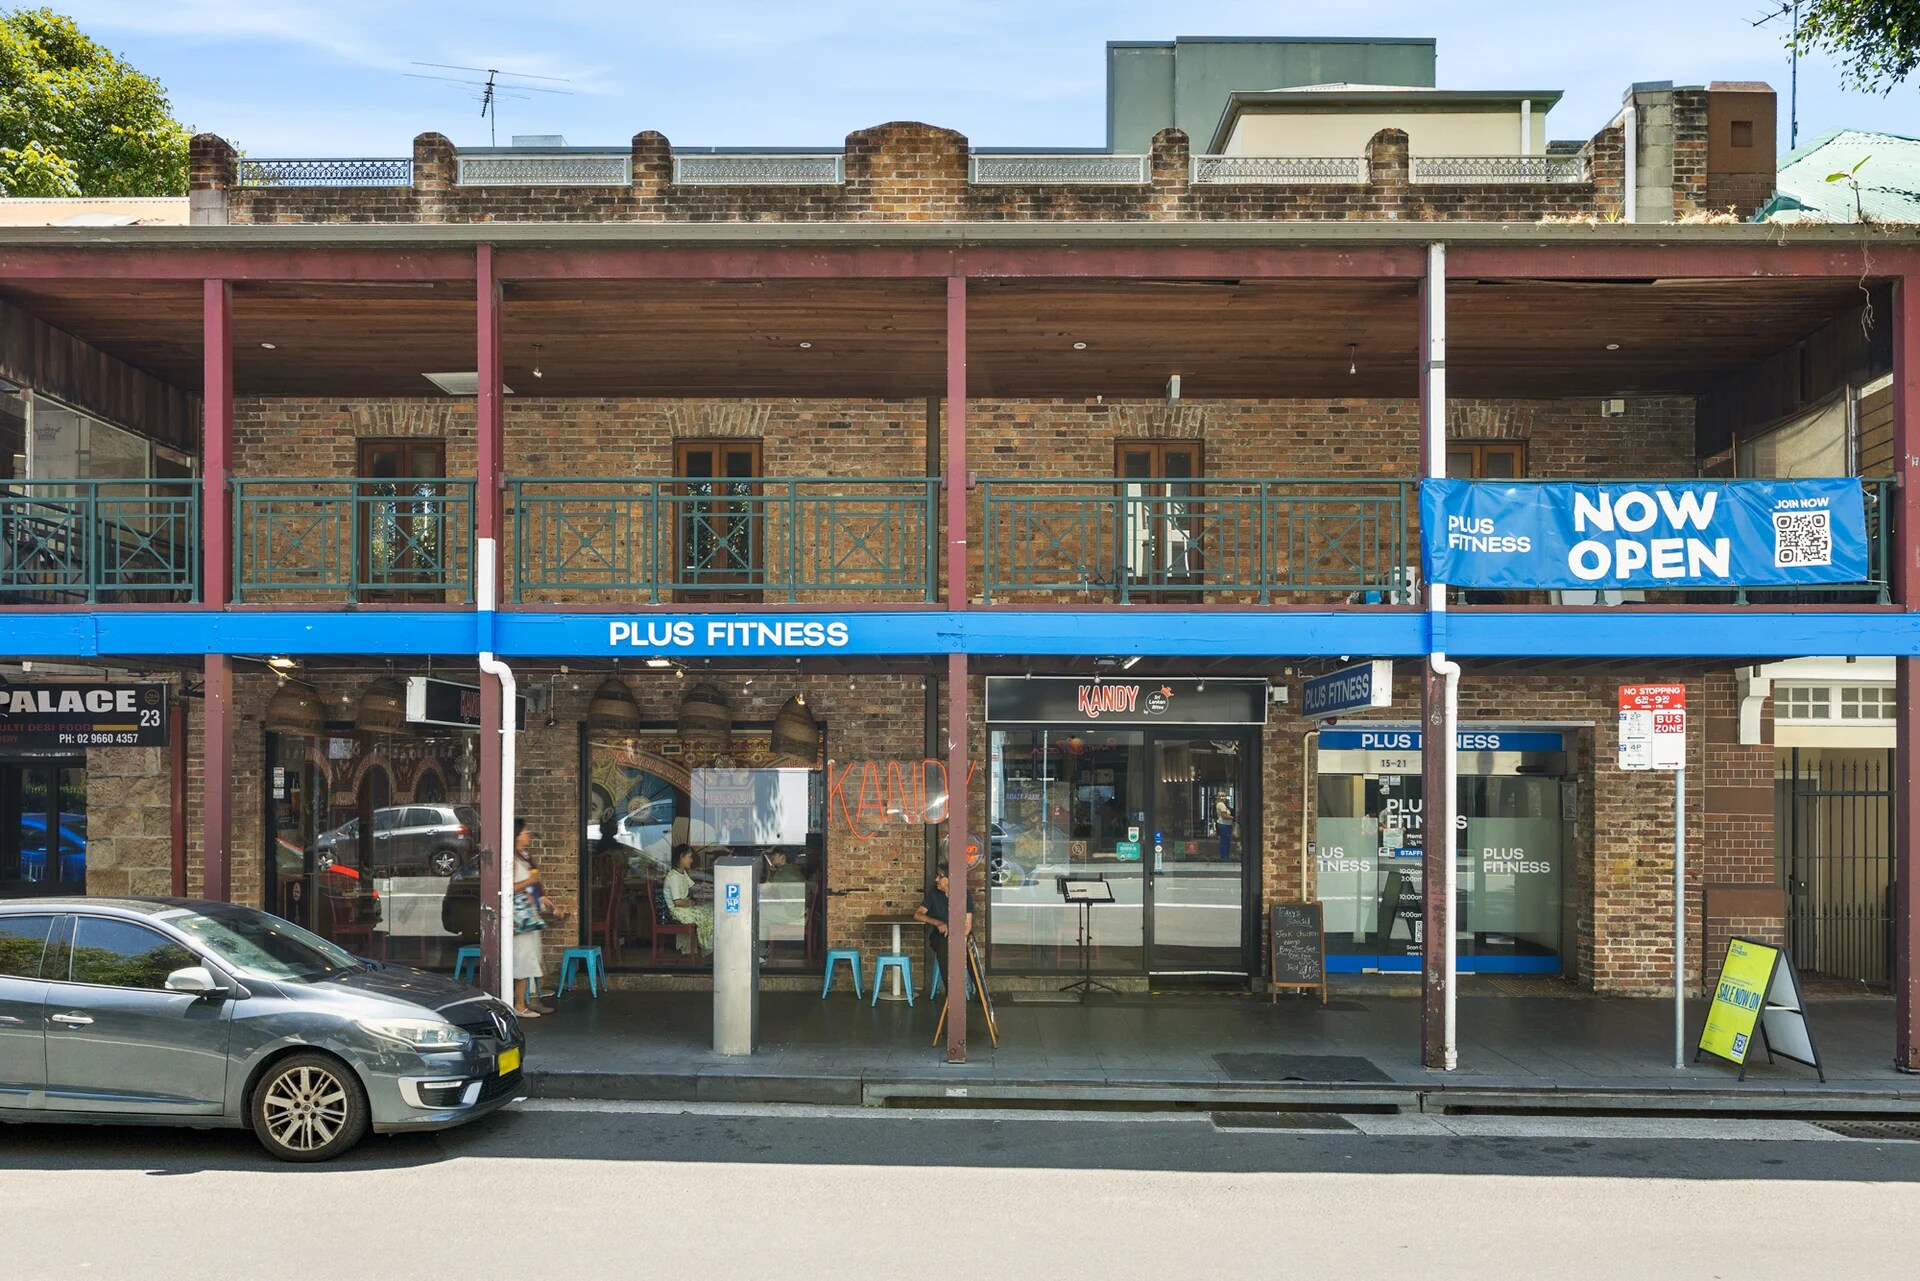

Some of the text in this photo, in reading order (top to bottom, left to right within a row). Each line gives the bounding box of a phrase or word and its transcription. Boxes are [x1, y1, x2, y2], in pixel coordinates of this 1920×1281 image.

[1774, 497, 1829, 509] JOIN NOW
[1573, 490, 1718, 533] NOW
[1448, 515, 1495, 534] PLUS
[1448, 533, 1531, 553] FITNESS
[1567, 537, 1731, 581] OPEN
[609, 622, 849, 647] PLUS FITNESS
[1305, 673, 1369, 710] PLUS FITNESS
[1639, 687, 1680, 695] STOPPING
[461, 690, 480, 723] KAN
[1078, 685, 1139, 718] KANDY
[140, 710, 160, 727] 23
[1656, 715, 1682, 723] BUS
[59, 734, 138, 744] PH: 02 9660 4357
[1361, 734, 1411, 748] PLUS
[1387, 799, 1422, 812] PLU
[1317, 847, 1344, 858] US
[1483, 848, 1524, 860] PLUS
[1317, 861, 1370, 872] TNESS
[1483, 861, 1551, 873] FITNESS
[728, 885, 737, 897] P
[1717, 983, 1761, 1010] SALE NOW ON
